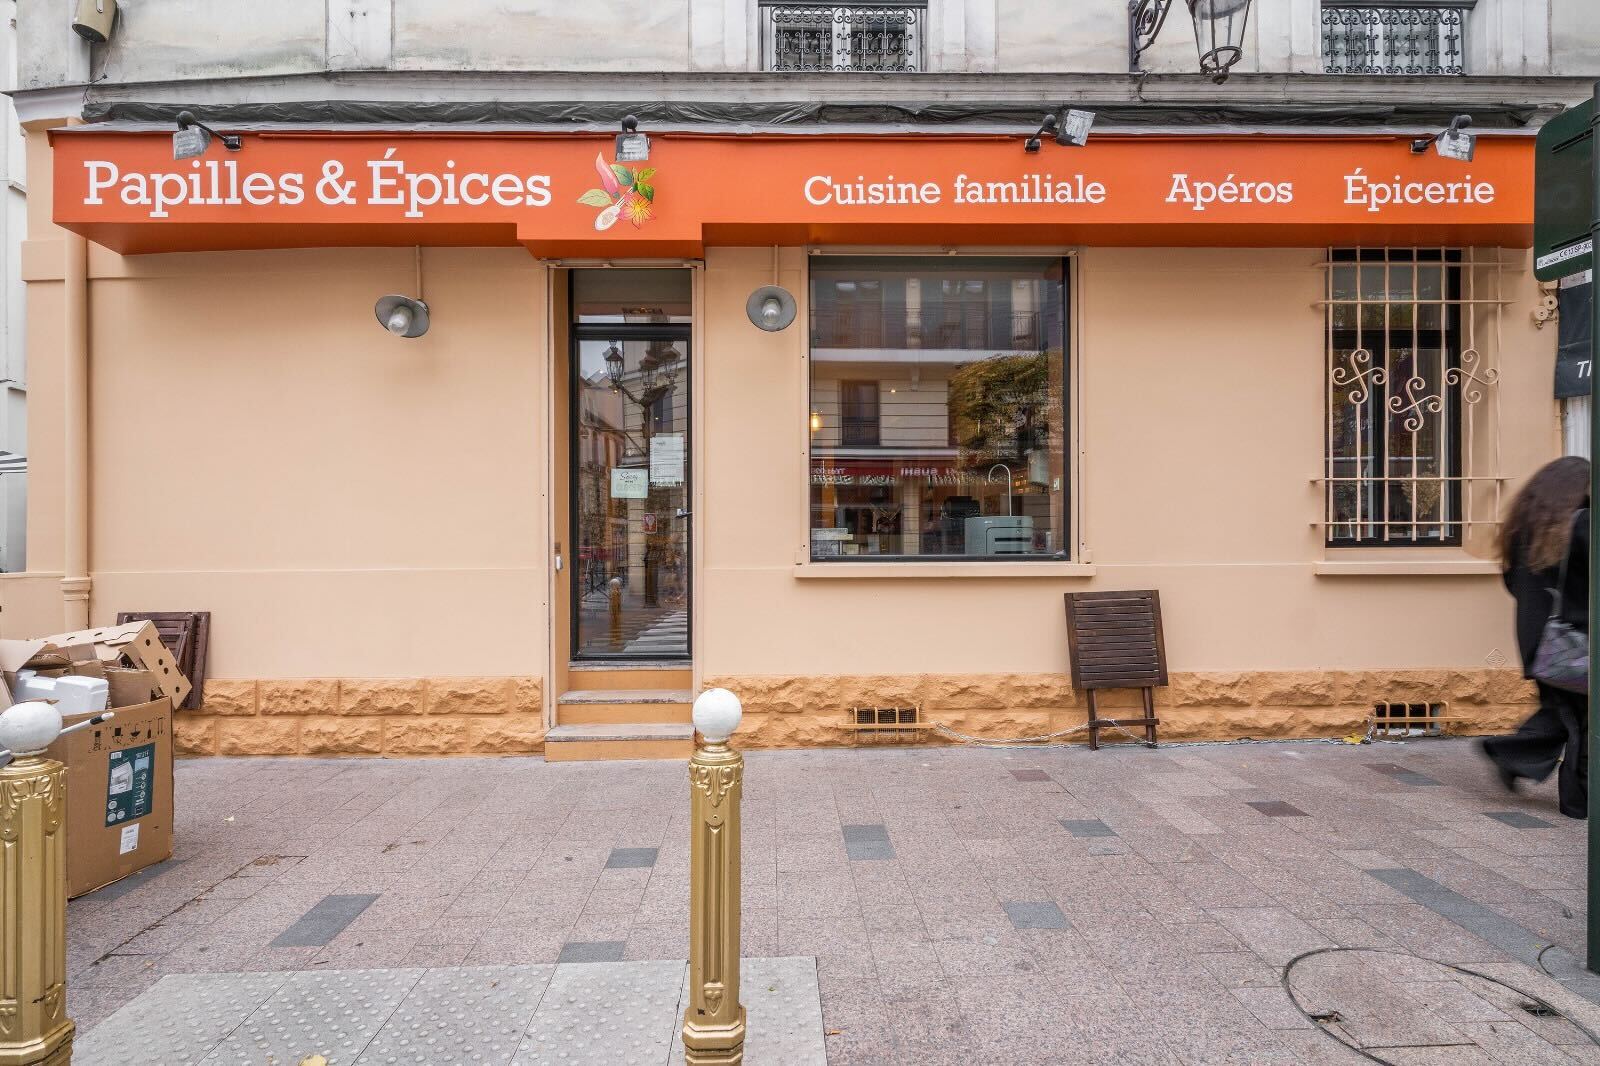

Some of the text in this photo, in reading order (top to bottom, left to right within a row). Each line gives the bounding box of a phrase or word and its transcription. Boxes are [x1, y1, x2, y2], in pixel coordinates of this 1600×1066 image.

[84, 148, 551, 218] Papilles & Épices
[804, 174, 1106, 205] Cuisine familiale
[1166, 173, 1294, 211] Apéros
[1344, 168, 1495, 212] Épicerie
